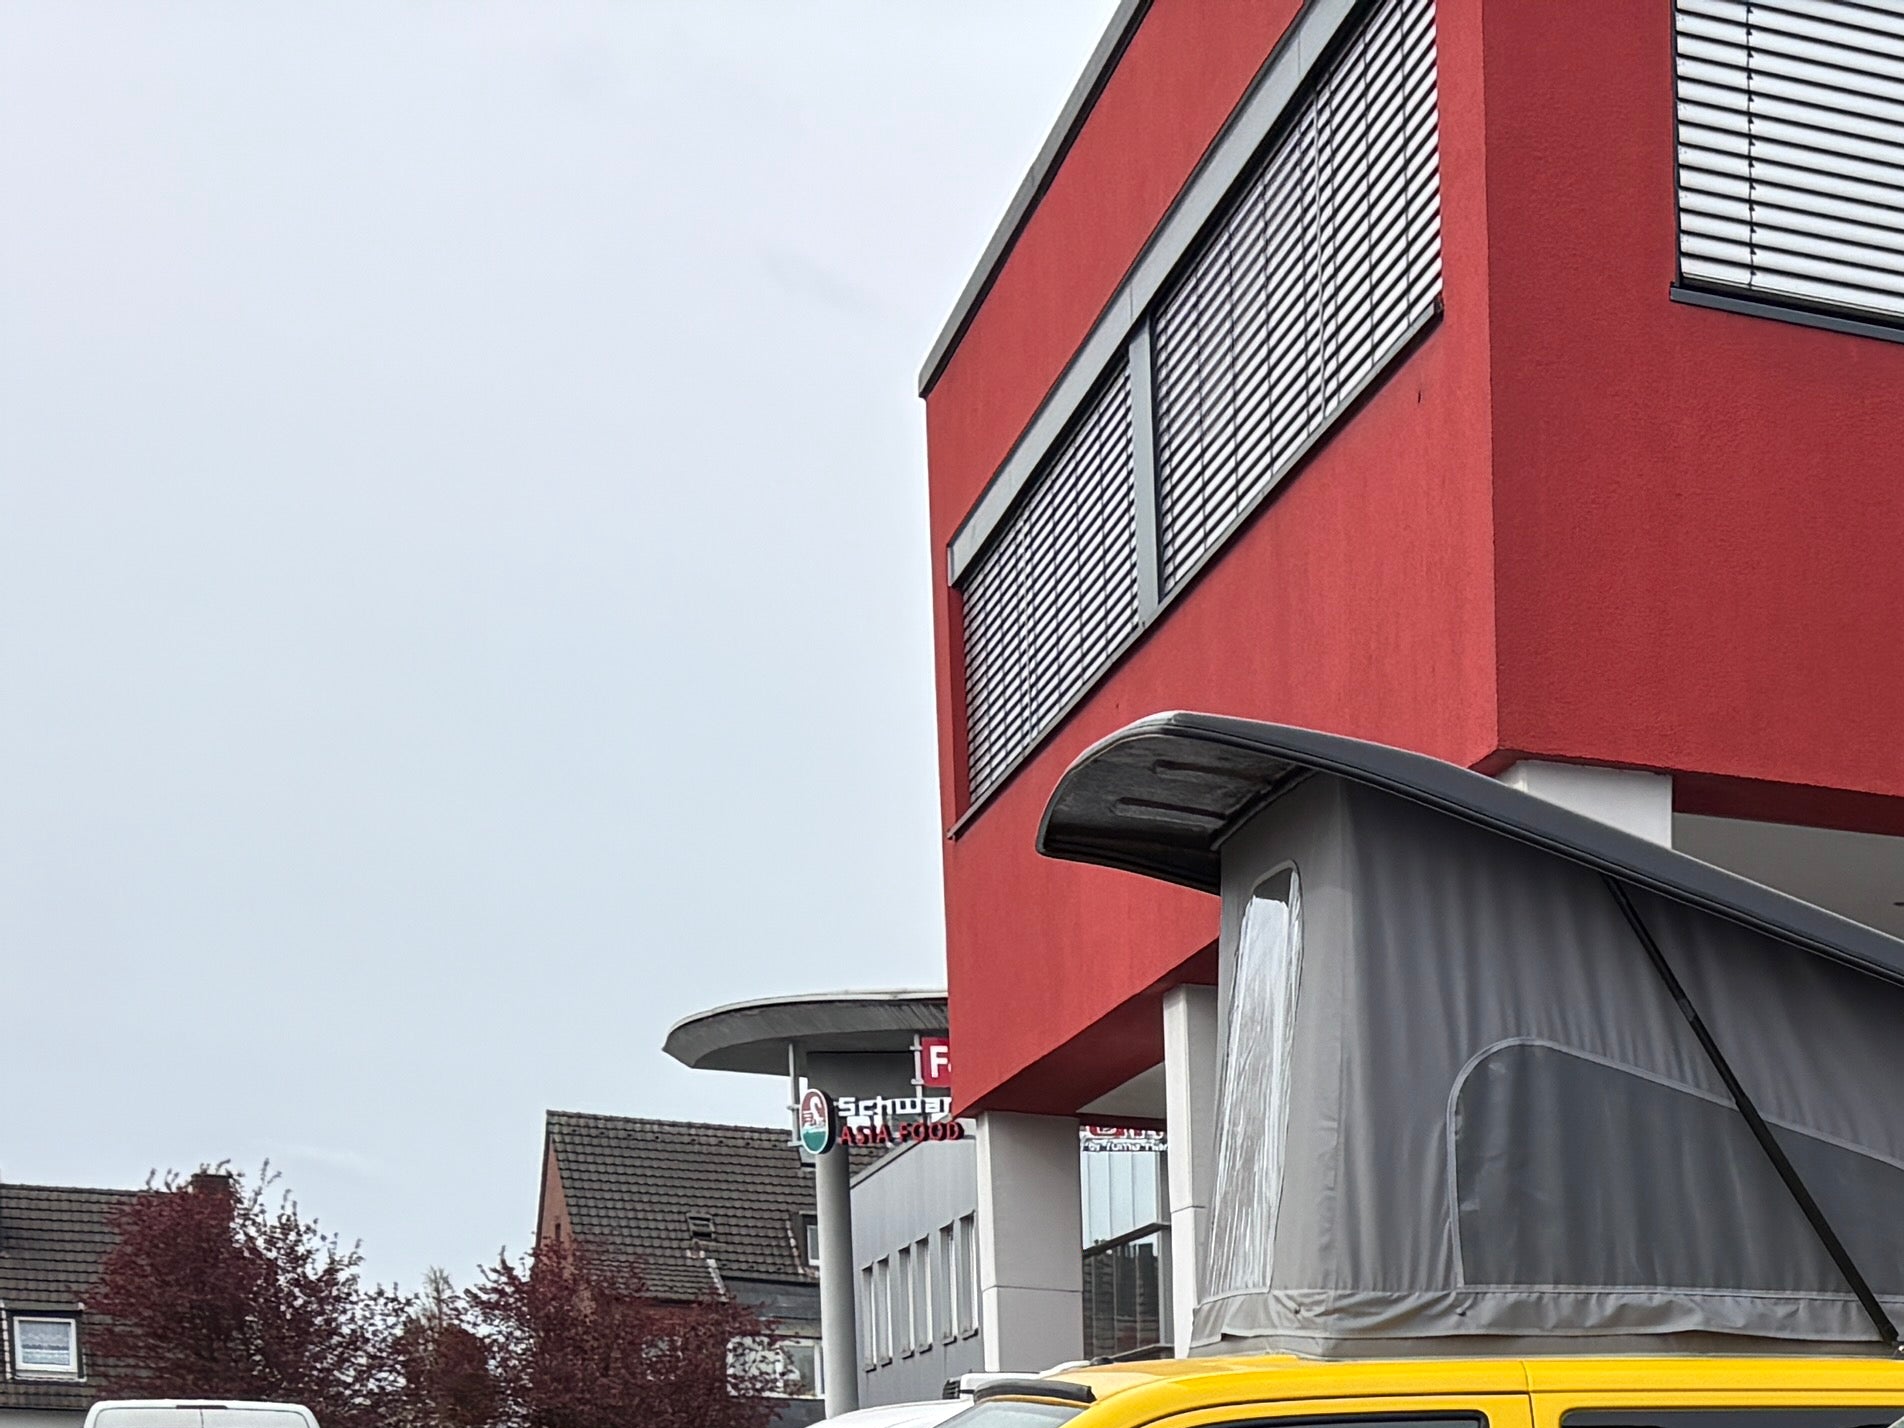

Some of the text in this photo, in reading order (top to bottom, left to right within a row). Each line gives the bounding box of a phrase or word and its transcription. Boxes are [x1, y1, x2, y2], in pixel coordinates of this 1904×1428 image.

[930, 1045, 951, 1078] F
[839, 1121, 962, 1145] ASIA FOOD
